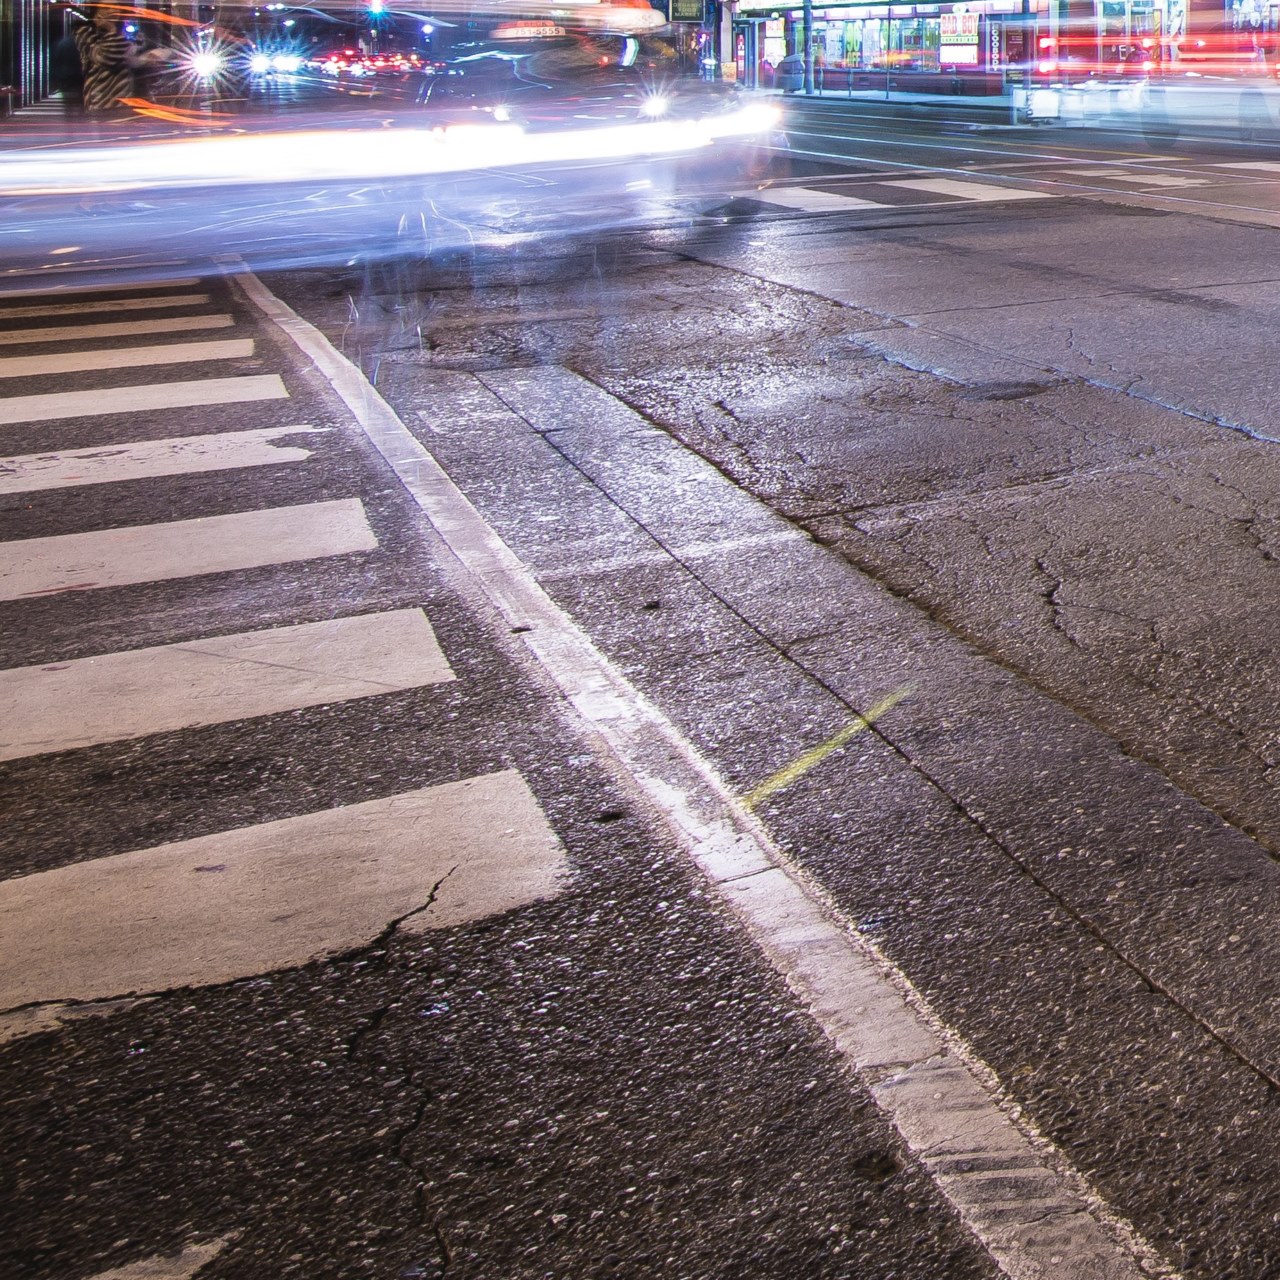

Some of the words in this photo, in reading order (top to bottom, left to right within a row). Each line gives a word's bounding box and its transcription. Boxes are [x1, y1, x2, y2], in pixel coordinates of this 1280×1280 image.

[514, 27, 562, 36] 751-5555
[942, 16, 957, 35] BAD
[962, 16, 978, 34] BOY
